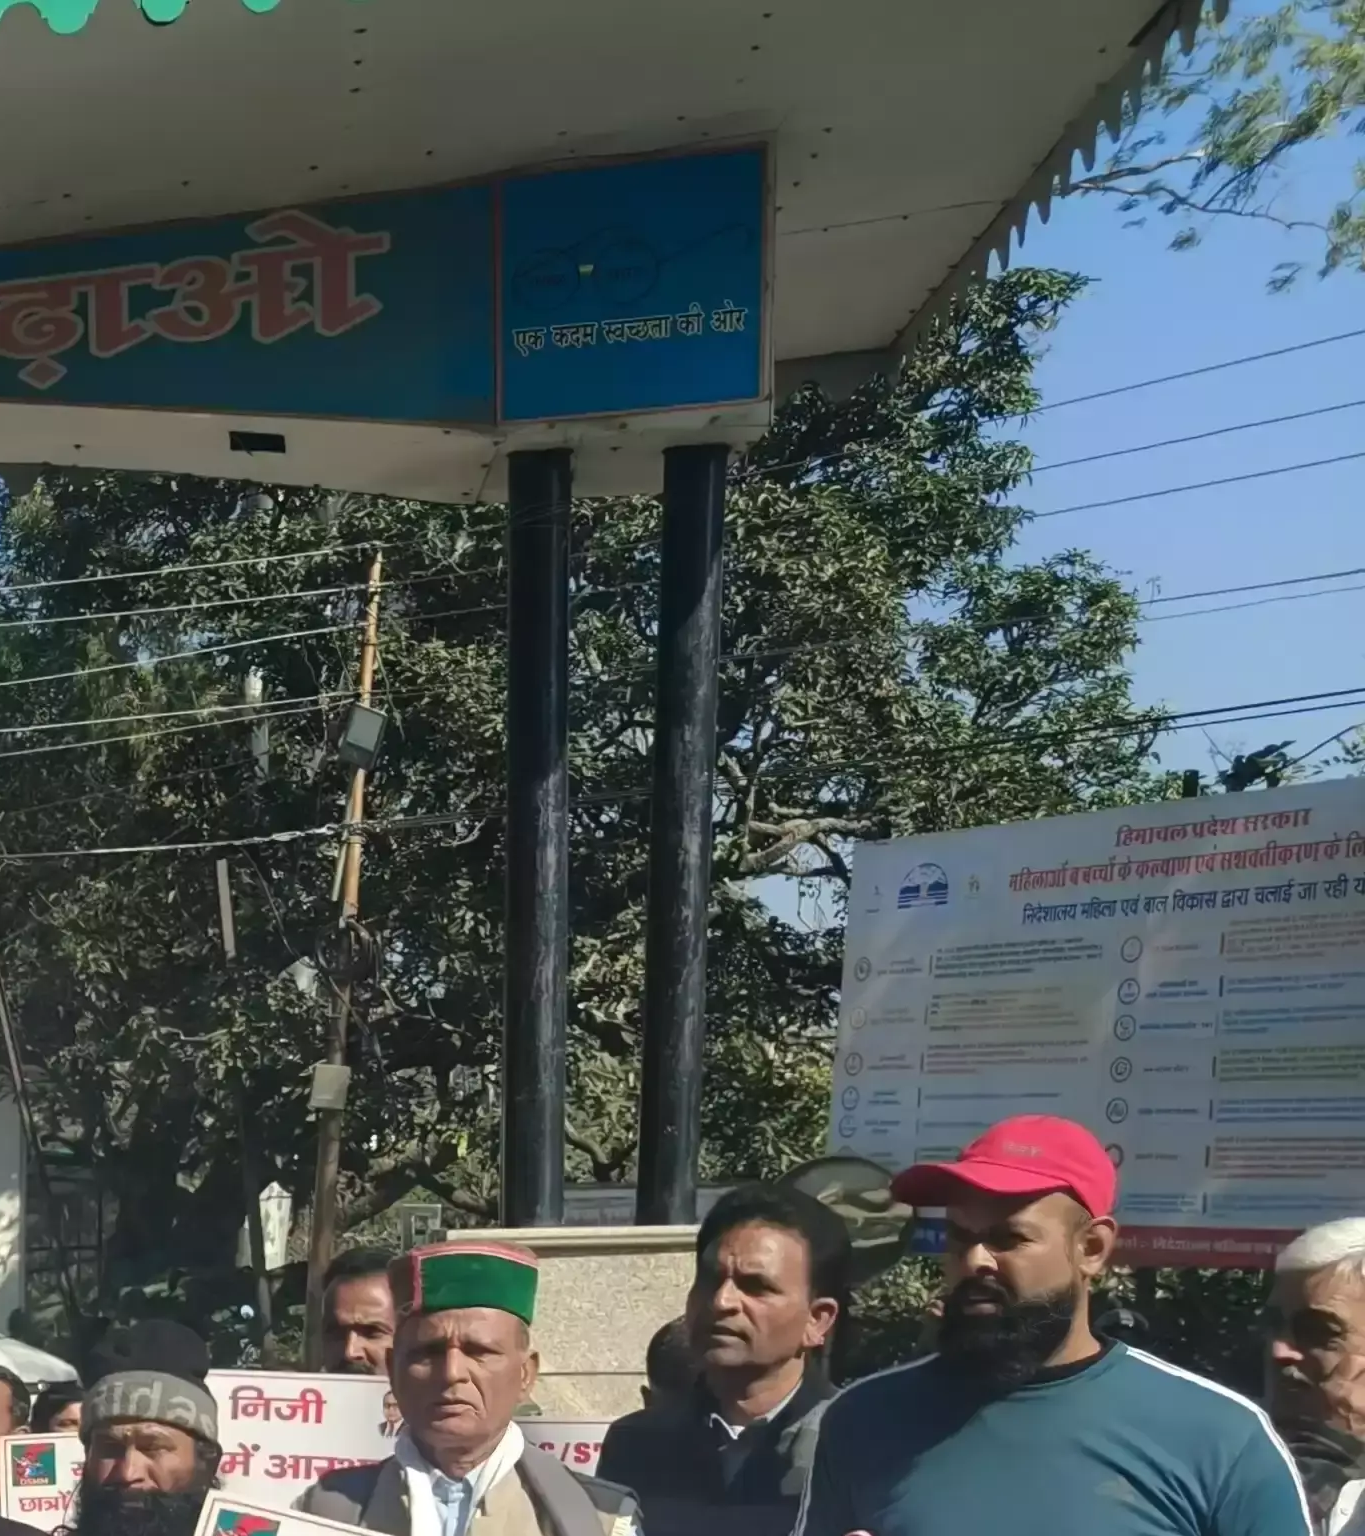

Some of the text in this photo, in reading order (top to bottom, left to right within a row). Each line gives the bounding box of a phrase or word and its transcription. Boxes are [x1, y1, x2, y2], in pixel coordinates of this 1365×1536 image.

[513, 299, 747, 356] एक कदम स्वच्छता की ओर
[1114, 807, 1313, 848] हिमाचल प्रदेश सरकार
[1322, 831, 1343, 860] के
[1022, 901, 1077, 926] निदेशालय
[1080, 896, 1117, 920] महिला
[1120, 893, 1142, 917] एवं
[1144, 892, 1168, 915] बाल
[1171, 888, 1217, 913] विकास
[1220, 885, 1248, 909] द्वारा
[1254, 877, 1294, 906] चलाई
[1297, 879, 1318, 902] जा
[1323, 874, 1348, 898] रही
[229, 1385, 327, 1425] निजी
[220, 1441, 261, 1478] में
[19, 1489, 72, 1513] छात्रों
